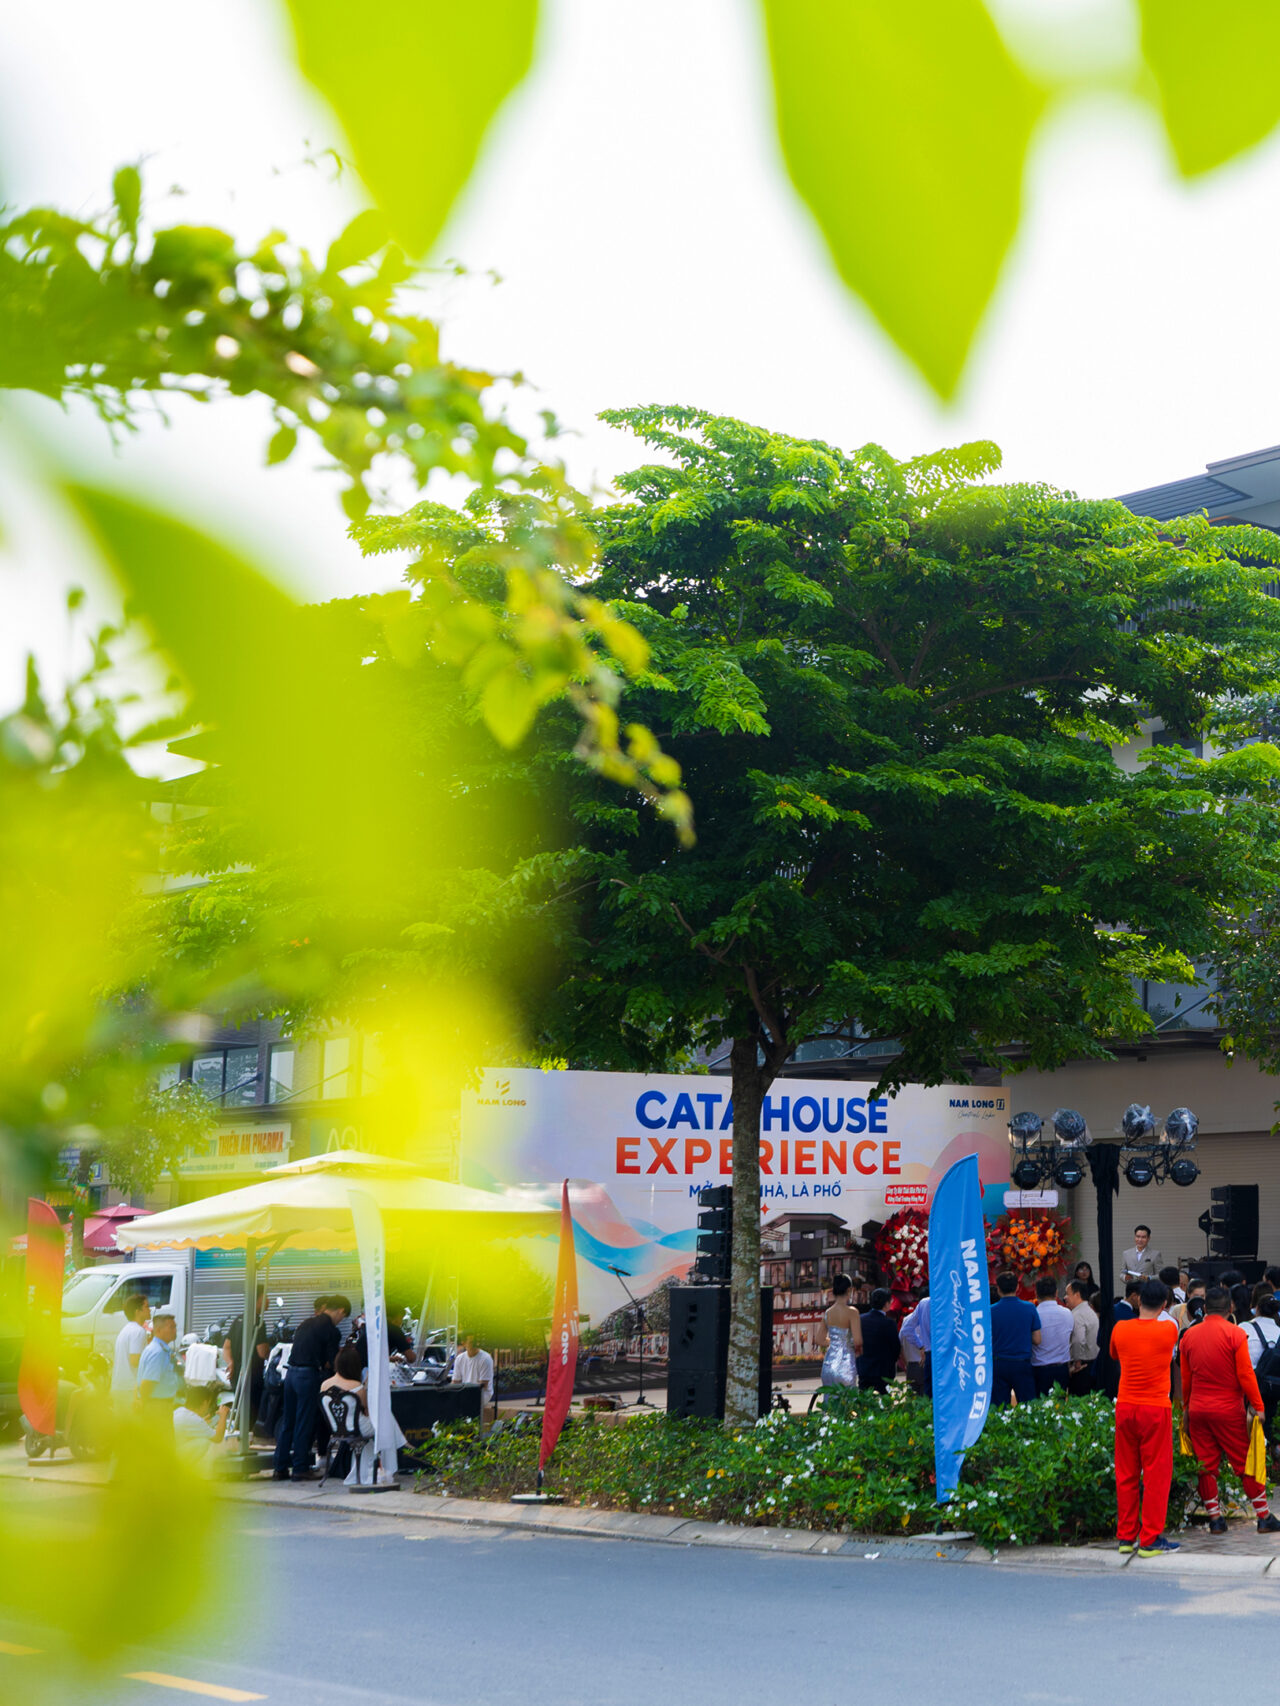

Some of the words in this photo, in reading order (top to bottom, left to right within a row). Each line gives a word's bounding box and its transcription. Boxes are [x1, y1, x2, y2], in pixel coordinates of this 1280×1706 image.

[763, 1095, 888, 1134] HOUSE
[949, 1099, 969, 1108] NAM
[972, 1099, 994, 1109] LONG
[615, 1137, 902, 1175] EXPERIENCE
[792, 1182, 808, 1198] LÀ
[813, 1180, 842, 1198] PHỐ
[960, 1238, 982, 1303] NAM
[970, 1310, 987, 1386] LONG
